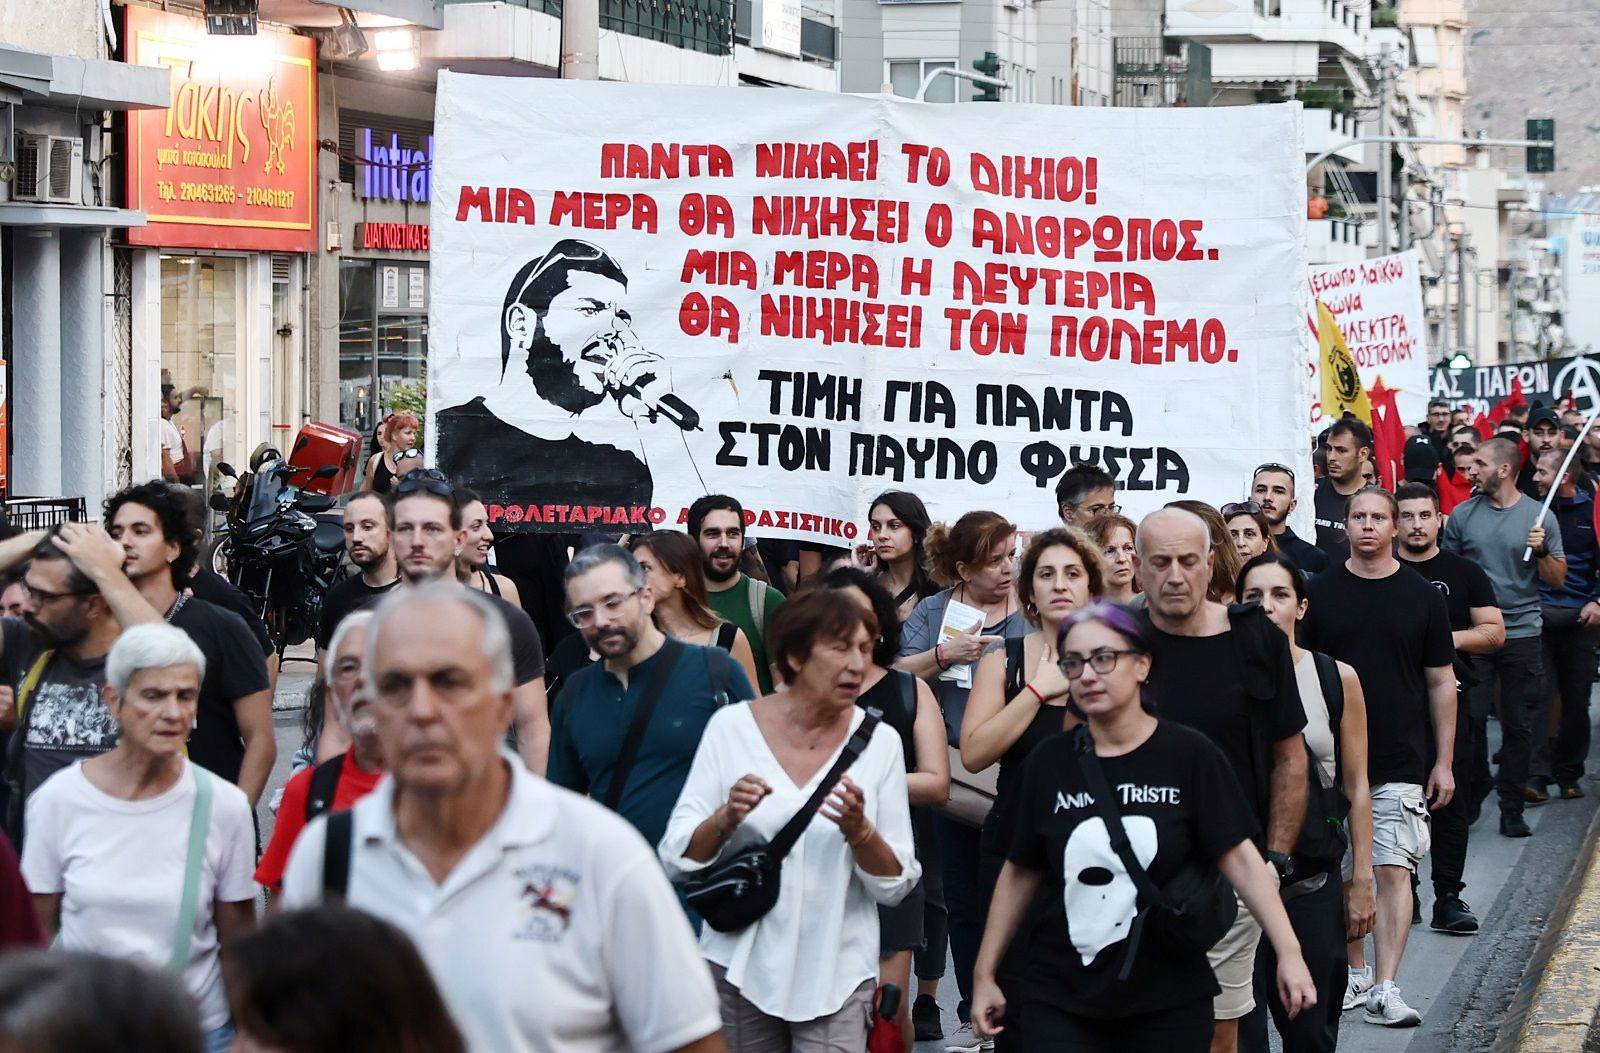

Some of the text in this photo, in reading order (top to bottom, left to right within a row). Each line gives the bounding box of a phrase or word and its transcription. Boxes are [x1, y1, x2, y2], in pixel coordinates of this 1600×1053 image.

[602, 140, 1097, 205] ΠΑΝΤΑ ΝΙΚΑΕΙ ΤΟ ΔΙΚΙΟ!
[363, 223, 421, 250] ΔΙΑΓΝΩΣΤΙΚΑ
[456, 186, 1219, 262] ΜΙΑ ΜΕΡΑ ΘΑ ΝΙΚΗΣΕΙ Ο ΑΝΘΡΩΠΟΣ.
[681, 249, 1156, 315] ΜΙΑ ΜΕΡΑ Η ΛΕΥΤΕΡΙΑ
[679, 292, 1238, 364] ΘΑ ΝΙΚΗΣΕΙ ΤΟΝ ΠΟΛΕΜΟ.
[758, 370, 1133, 436] ΤΙΜΗ ΓΙΑ ΠΑΝΤΑ
[1475, 363, 1549, 397] ΠΑΡΩΝ
[715, 421, 831, 471] ΣΤΟΝ
[848, 432, 997, 484] ΠΑΥΛΟ
